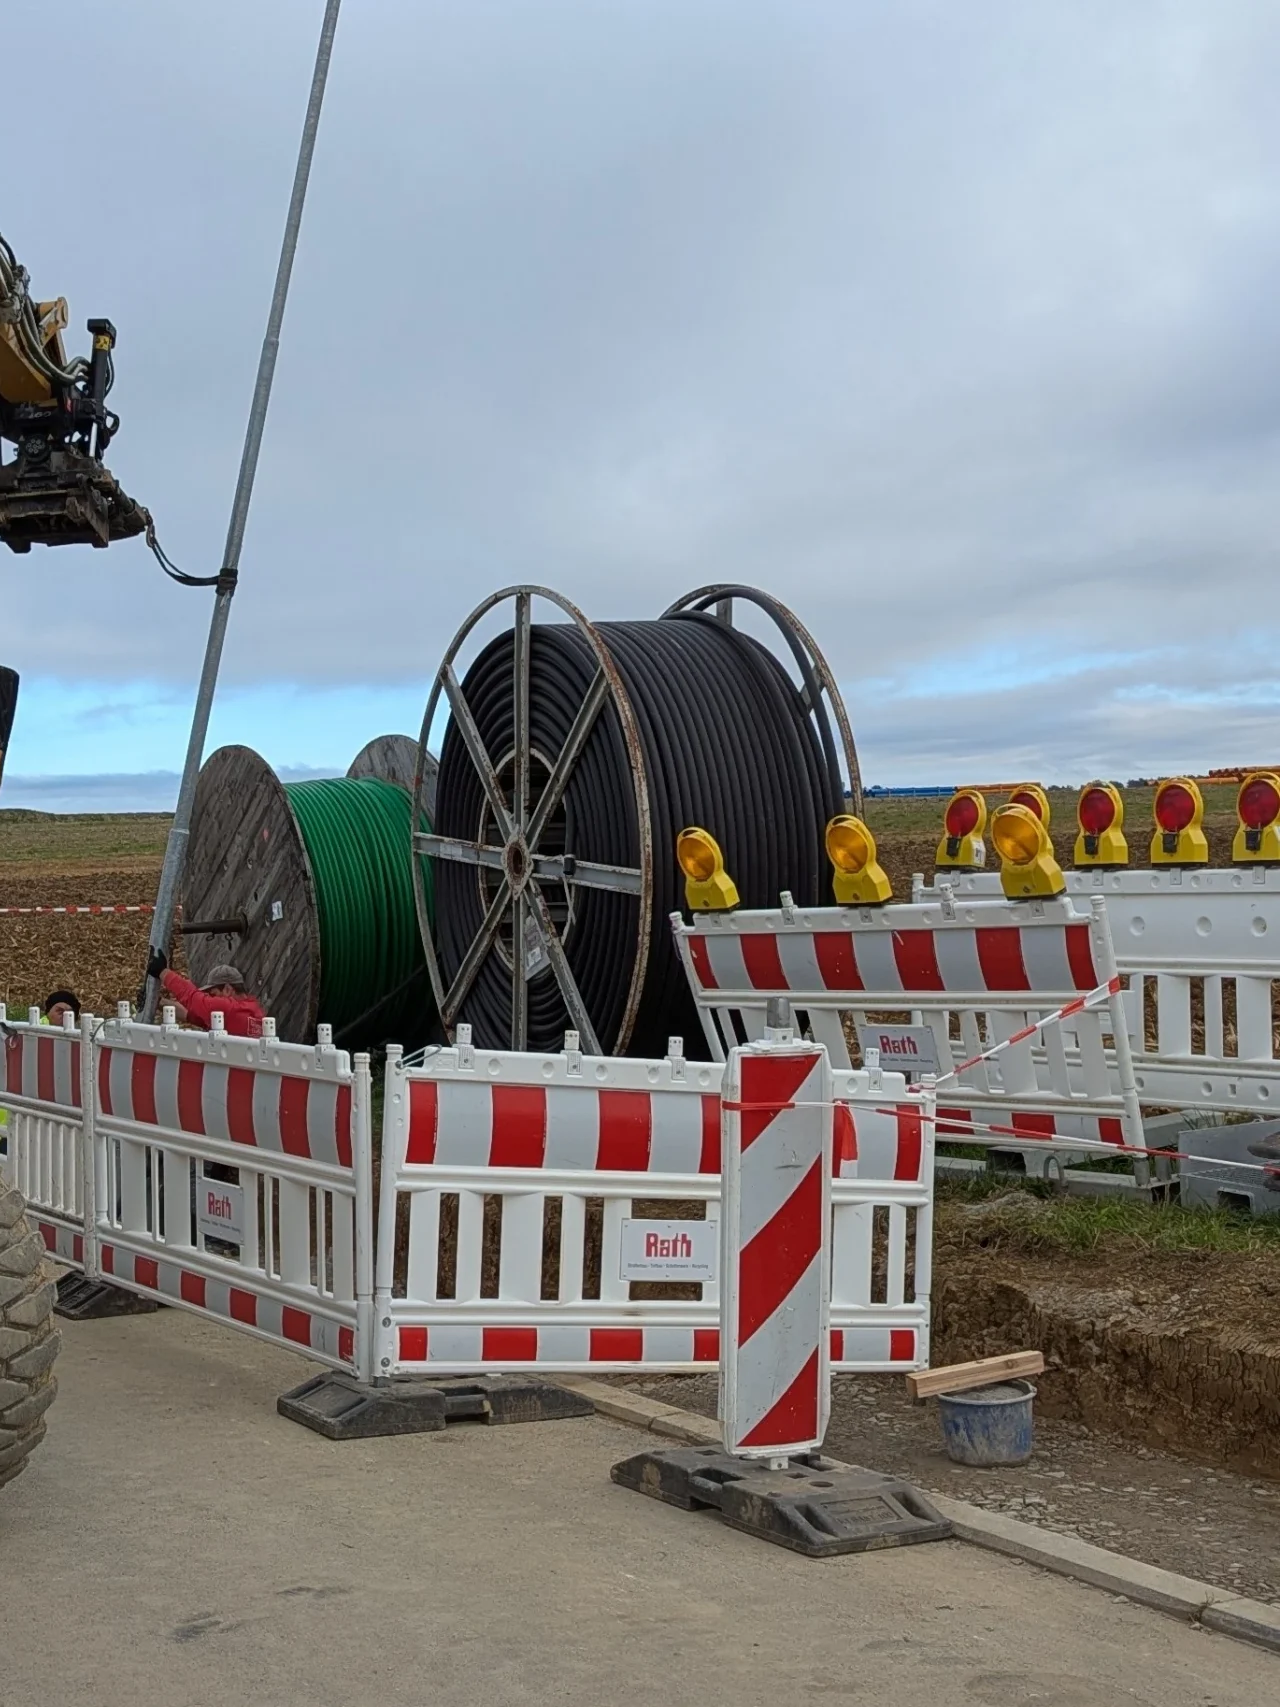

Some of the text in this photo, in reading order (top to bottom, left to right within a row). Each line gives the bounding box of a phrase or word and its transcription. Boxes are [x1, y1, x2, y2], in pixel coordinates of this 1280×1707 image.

[878, 1035, 918, 1055] Rath
[207, 1191, 232, 1220] Rath
[645, 1232, 692, 1258] Rath
